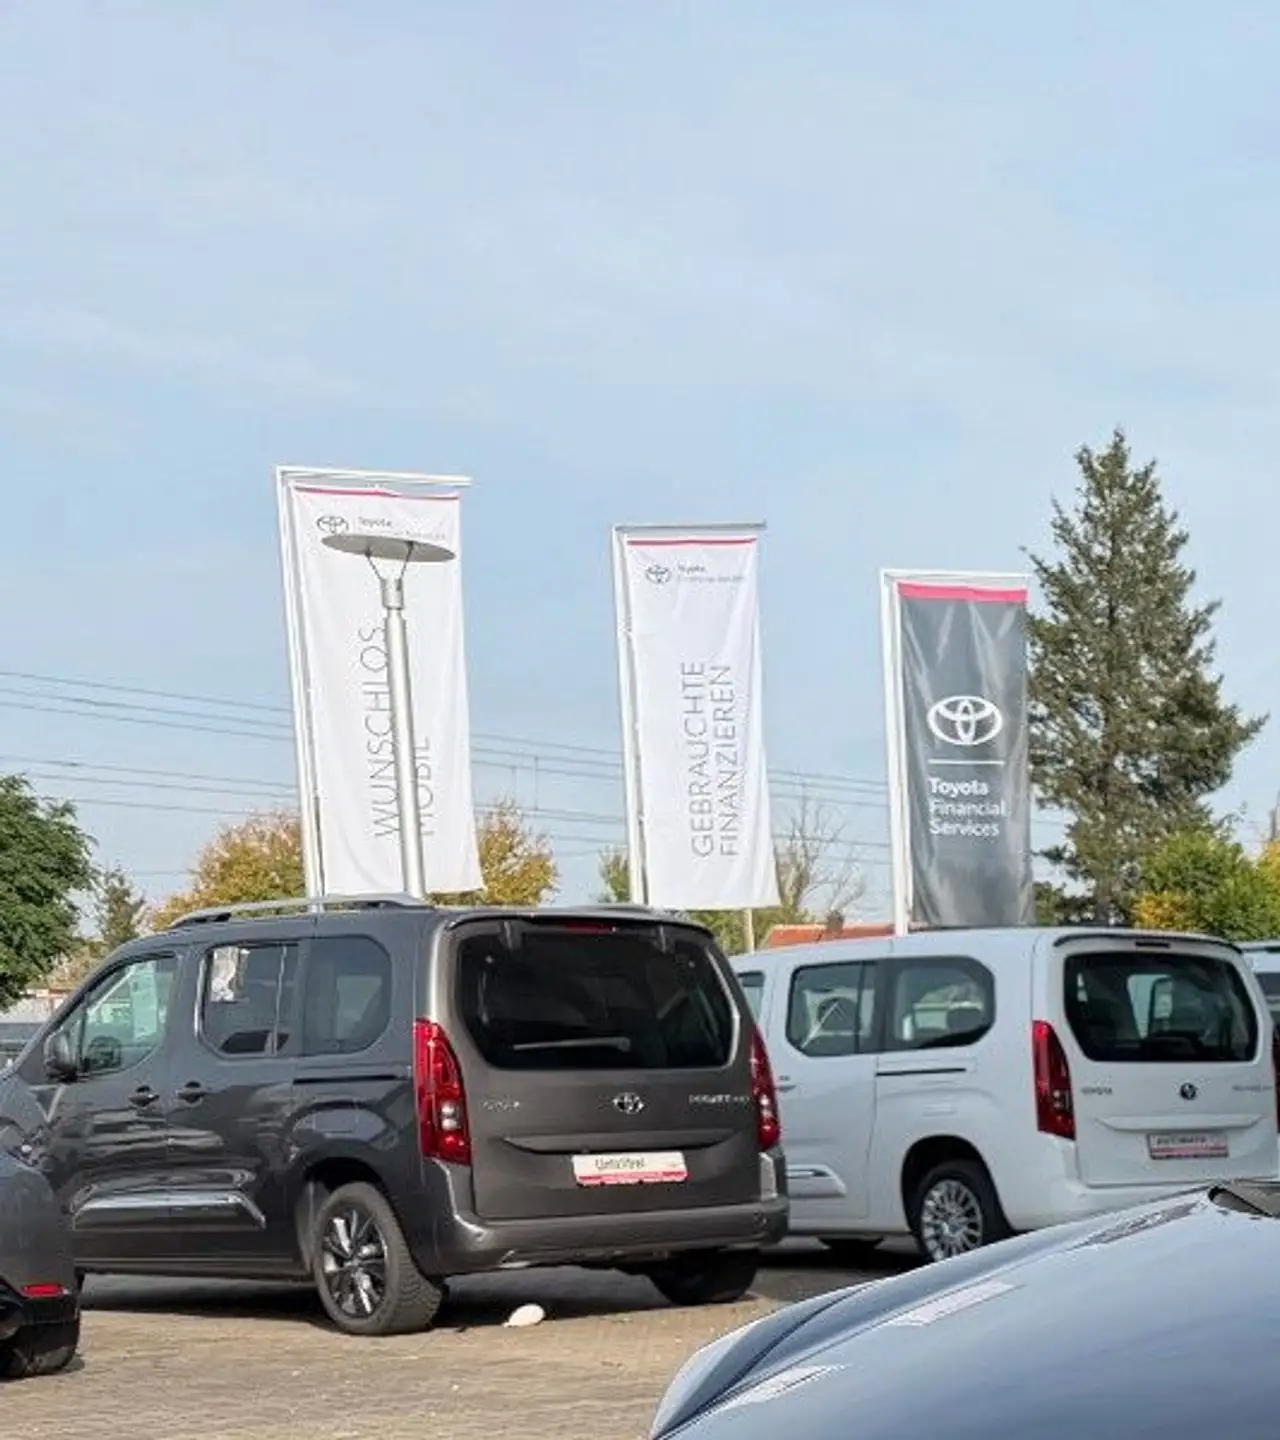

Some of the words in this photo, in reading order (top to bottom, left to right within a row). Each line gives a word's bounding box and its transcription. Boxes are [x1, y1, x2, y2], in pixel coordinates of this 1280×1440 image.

[680, 662, 714, 858] GEBRAUCHTE
[710, 665, 739, 857] FINANZIEREN
[927, 776, 988, 798] Toyota
[928, 799, 1005, 817] Financial
[928, 818, 1000, 836] Services
